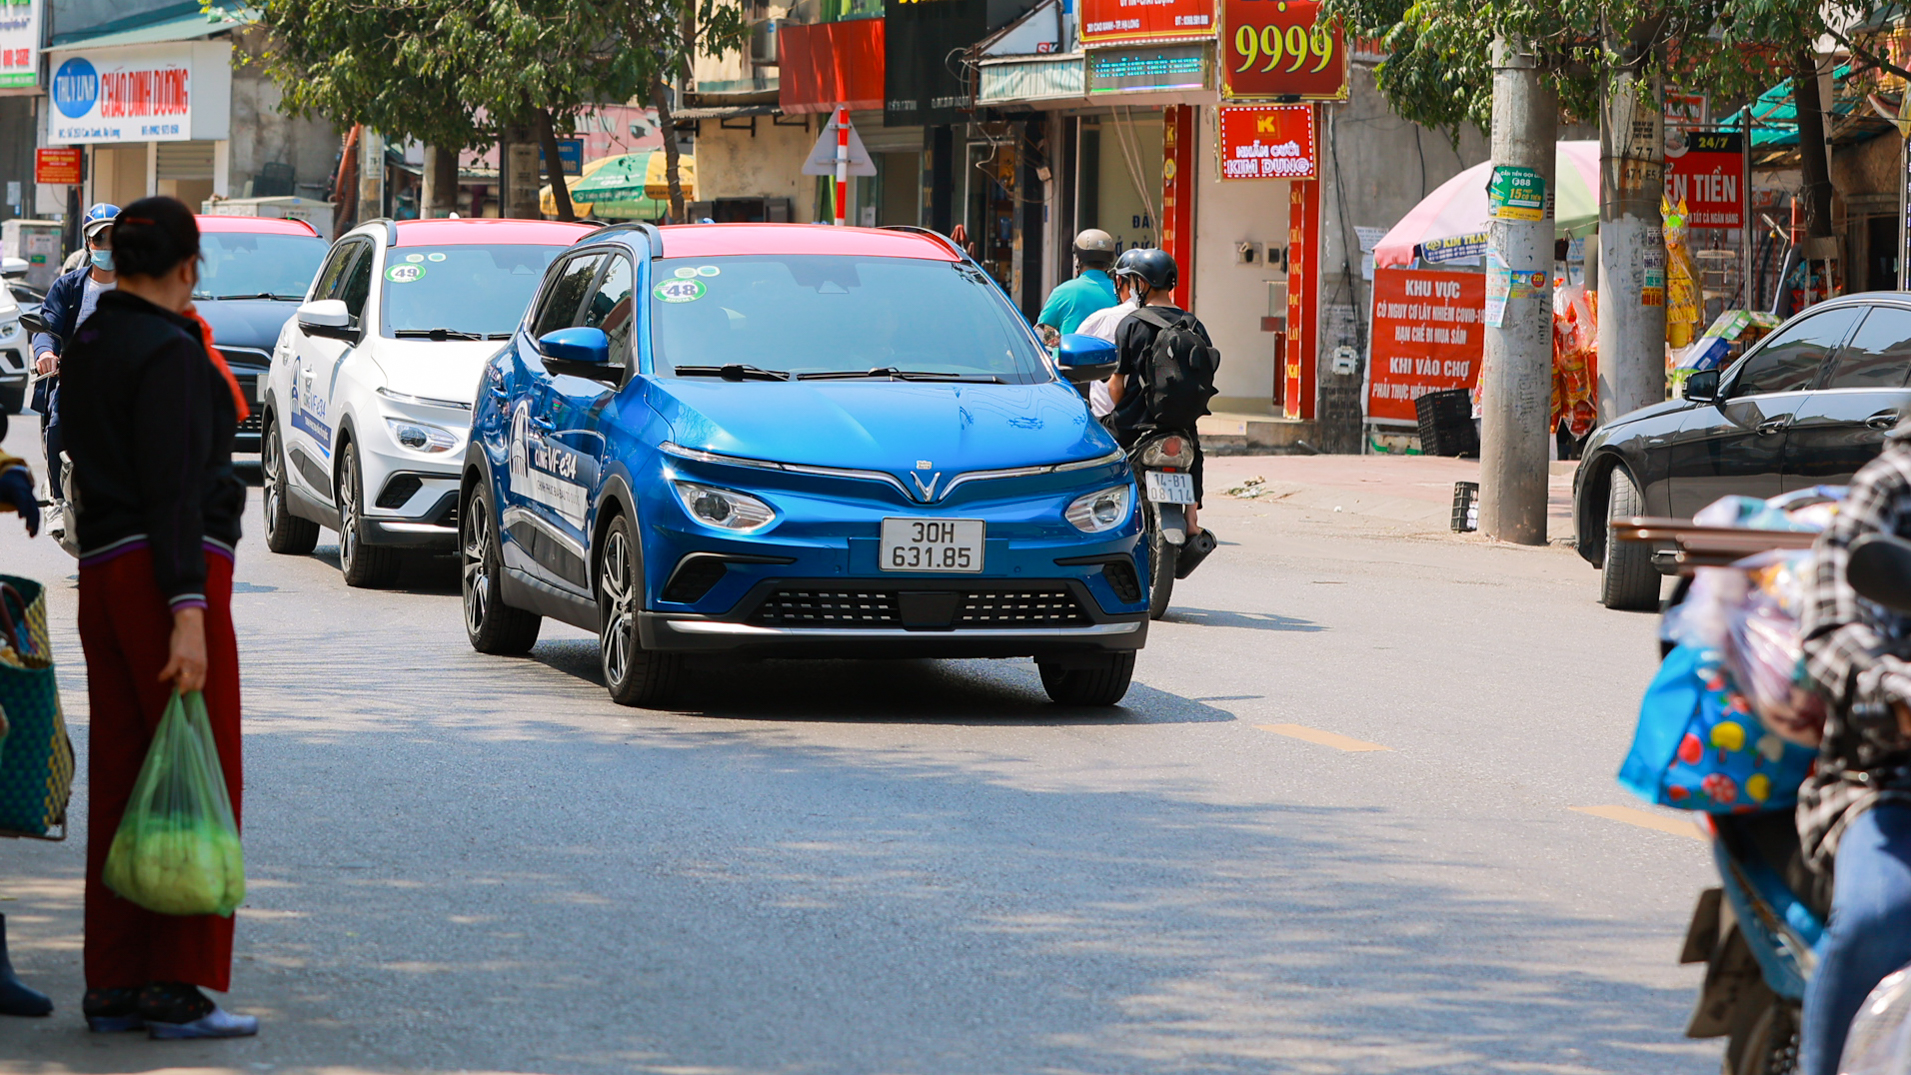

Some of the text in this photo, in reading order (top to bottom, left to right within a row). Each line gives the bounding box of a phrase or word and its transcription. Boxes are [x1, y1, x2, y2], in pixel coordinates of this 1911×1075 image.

[1235, 24, 1333, 73] 9999
[101, 65, 127, 118] CHÁO
[1256, 115, 1276, 133] K
[1235, 139, 1300, 158] NHẪN CƯỚI
[1698, 136, 1729, 149] 24/7
[1226, 158, 1259, 175] KIM
[1510, 188, 1522, 200] 15
[1693, 165, 1737, 203] TIỀN
[1443, 232, 1490, 248] KIM TRAN
[394, 267, 418, 279] 49
[665, 283, 697, 297] 48
[1405, 279, 1461, 302] KHU VỰC
[1376, 299, 1387, 318] CÓ
[1387, 303, 1408, 319] NGUY
[1408, 303, 1419, 320] CƠ
[1394, 325, 1411, 345] HẠN
[1411, 322, 1426, 342] CHẾ
[1434, 328, 1450, 344] MUA
[1450, 324, 1467, 345] SẮM
[1389, 355, 1470, 381] KHI VÀO CHỢ
[1371, 377, 1390, 399] PHẢI
[1390, 383, 1410, 403] THỰC
[547, 446, 562, 474] VF
[559, 452, 578, 480] e34
[1154, 473, 1186, 488] 14-B1
[1150, 487, 1193, 502] 081.14
[911, 521, 955, 544] 30H
[892, 546, 972, 568] 631.85
